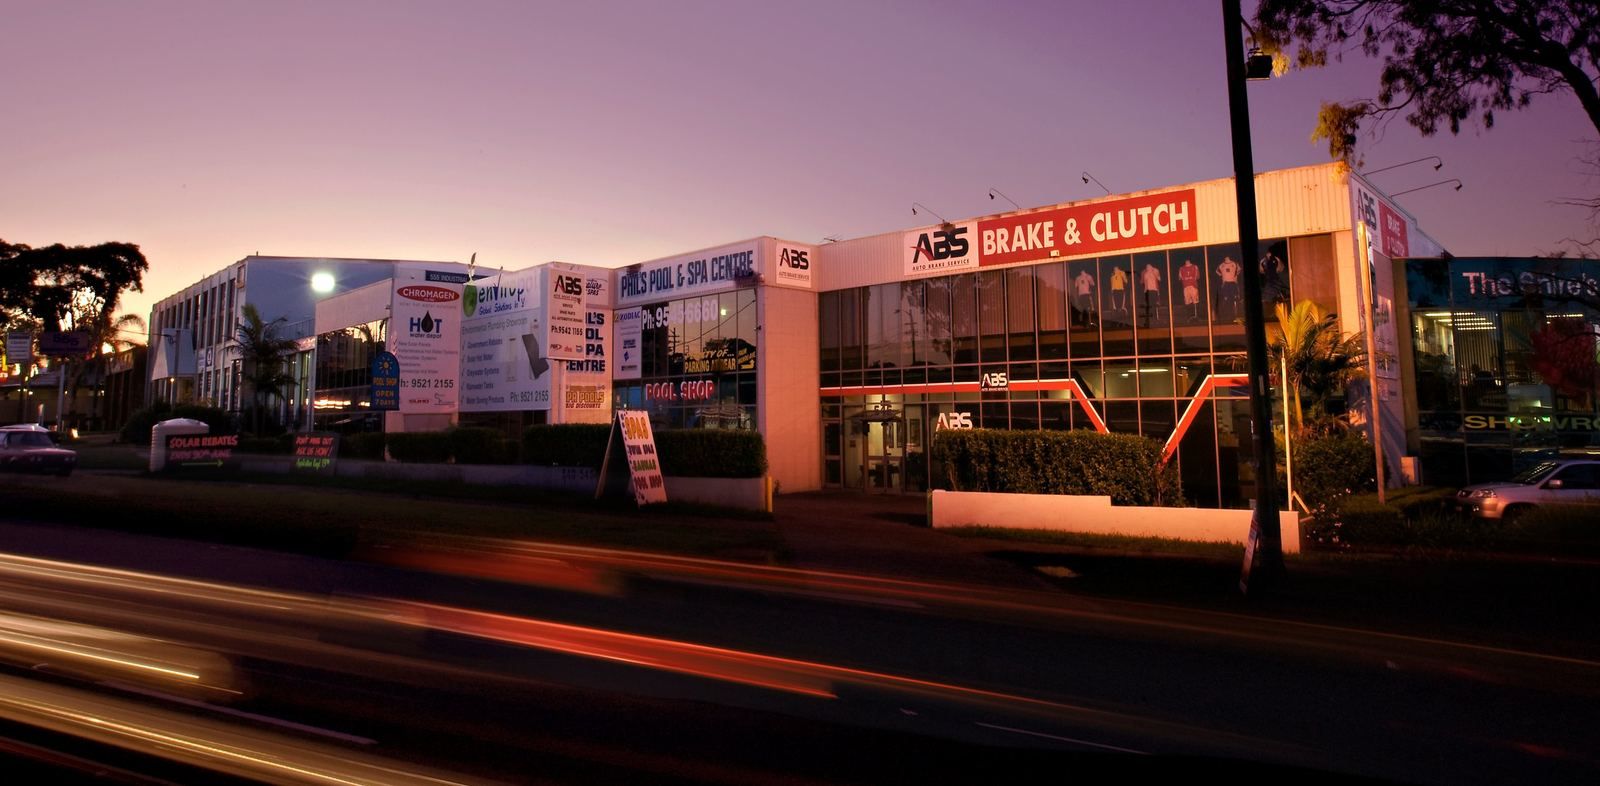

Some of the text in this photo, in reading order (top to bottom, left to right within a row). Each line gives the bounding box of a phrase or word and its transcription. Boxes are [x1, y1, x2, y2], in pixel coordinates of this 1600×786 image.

[1357, 188, 1377, 231] ABS
[983, 201, 1189, 256] BRAKE & CLUTCH
[911, 227, 969, 263] ABS
[779, 248, 809, 270] ABS
[621, 250, 753, 297] PHIL'S POOL & SPA CENTRE
[554, 274, 582, 296] ABS
[1462, 271, 1513, 296] The
[402, 288, 455, 300] CHROMAGEN
[585, 312, 604, 325] IL'S
[620, 311, 640, 321] ZODIAC
[642, 309, 655, 329] Ph:
[585, 328, 604, 340] OL
[585, 343, 604, 356] PA
[684, 361, 709, 373] PARKING
[411, 378, 431, 388] 9521
[433, 379, 454, 388] 2155
[982, 373, 1008, 387] ABS
[510, 390, 549, 402] Ph: 9521 2155
[566, 391, 604, 403] PA POOLS
[645, 380, 715, 401] POOL SHOP
[936, 412, 973, 432] ABS
[169, 434, 239, 449] SOLAR REBATES
